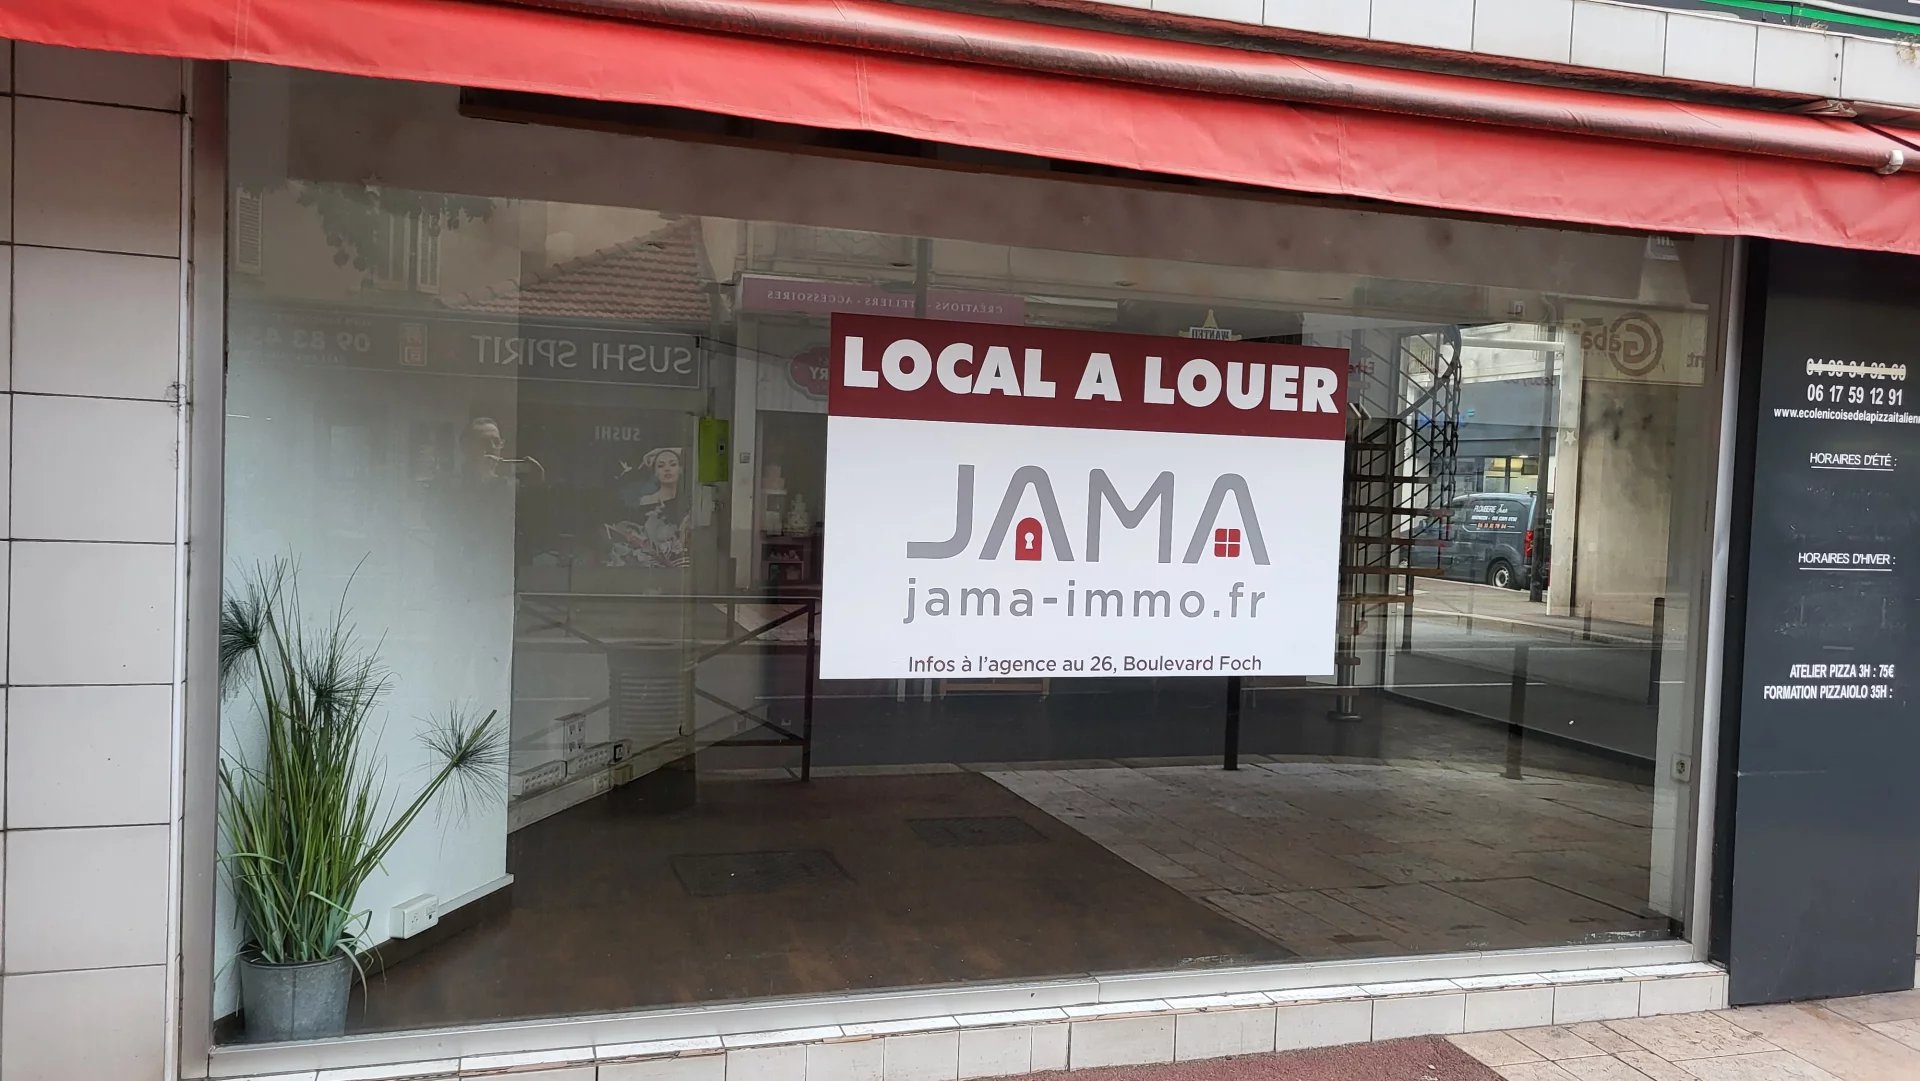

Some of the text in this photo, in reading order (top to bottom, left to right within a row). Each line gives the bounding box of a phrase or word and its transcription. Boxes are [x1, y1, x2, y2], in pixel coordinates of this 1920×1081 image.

[843, 335, 1339, 414] LOCAL A LOUER
[1807, 384, 1903, 406] 06 17 59 12 91
[1809, 452, 1862, 466] HORAIRES
[906, 464, 1271, 566] JAMA
[1798, 552, 1850, 564] HORAIRES
[1852, 553, 1891, 565] D'HIVER
[902, 577, 1266, 624] jama-immo.fr
[908, 656, 956, 673] Infos
[961, 655, 973, 673] à
[1062, 659, 1085, 673] au
[1090, 656, 1117, 674] 26,
[1123, 655, 1213, 672] Boulevard
[1219, 655, 1262, 671] Foch
[1789, 664, 1827, 678] ATELIER
[1829, 664, 1857, 678] PIZZA
[1859, 664, 1871, 678] 3H
[1879, 664, 1895, 678] 75€
[1763, 685, 1818, 700] FORMATION
[1820, 684, 1868, 699] PIZZAIOLO
[1870, 684, 1888, 699] 35H
